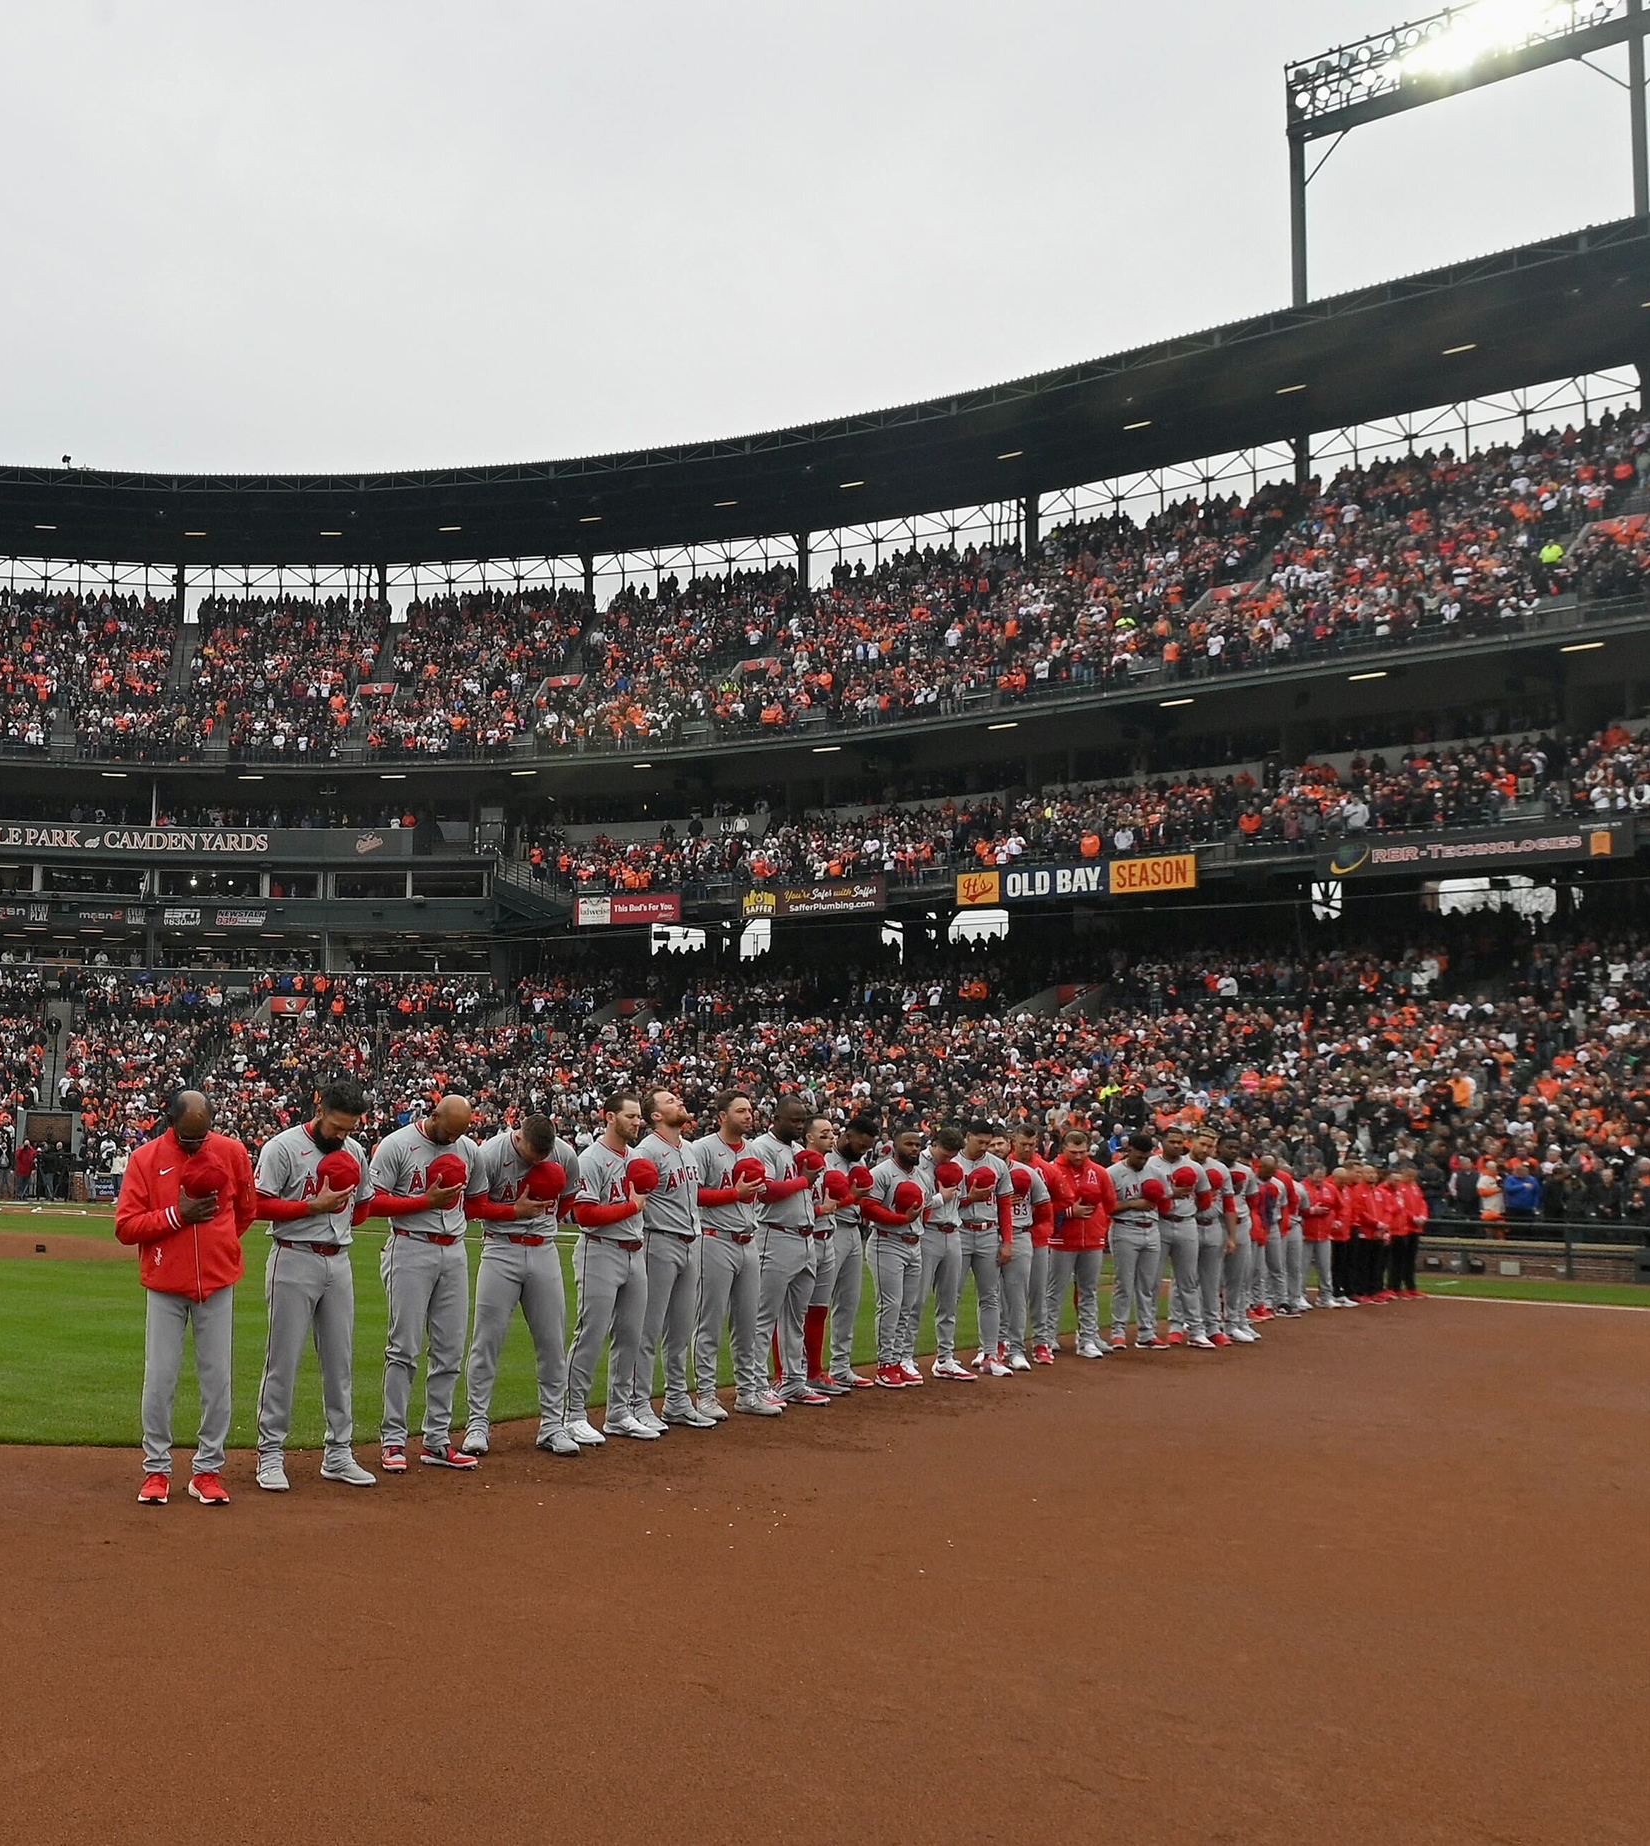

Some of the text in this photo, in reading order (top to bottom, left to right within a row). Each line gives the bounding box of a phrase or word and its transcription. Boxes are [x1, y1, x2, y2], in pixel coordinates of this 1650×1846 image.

[24, 828, 82, 848] PARK
[84, 837, 101, 849] at
[103, 830, 198, 851] CAMDEN
[198, 833, 269, 852] YARDS
[962, 873, 994, 897] It's
[1006, 868, 1050, 898] OLD
[1116, 859, 1187, 888] SEASON
[784, 885, 877, 902] You're Safer with Saffer
[614, 904, 628, 912] This
[629, 903, 647, 912] Bud's
[648, 903, 659, 911] For
[746, 905, 772, 914] SAFFER
[789, 900, 875, 912] SafferPlumbing.com
[164, 908, 201, 918] ESPN
[216, 910, 267, 918] NEWSTALK
[665, 1166, 699, 1193] ANGE
[1013, 1203, 1028, 1216] 63
